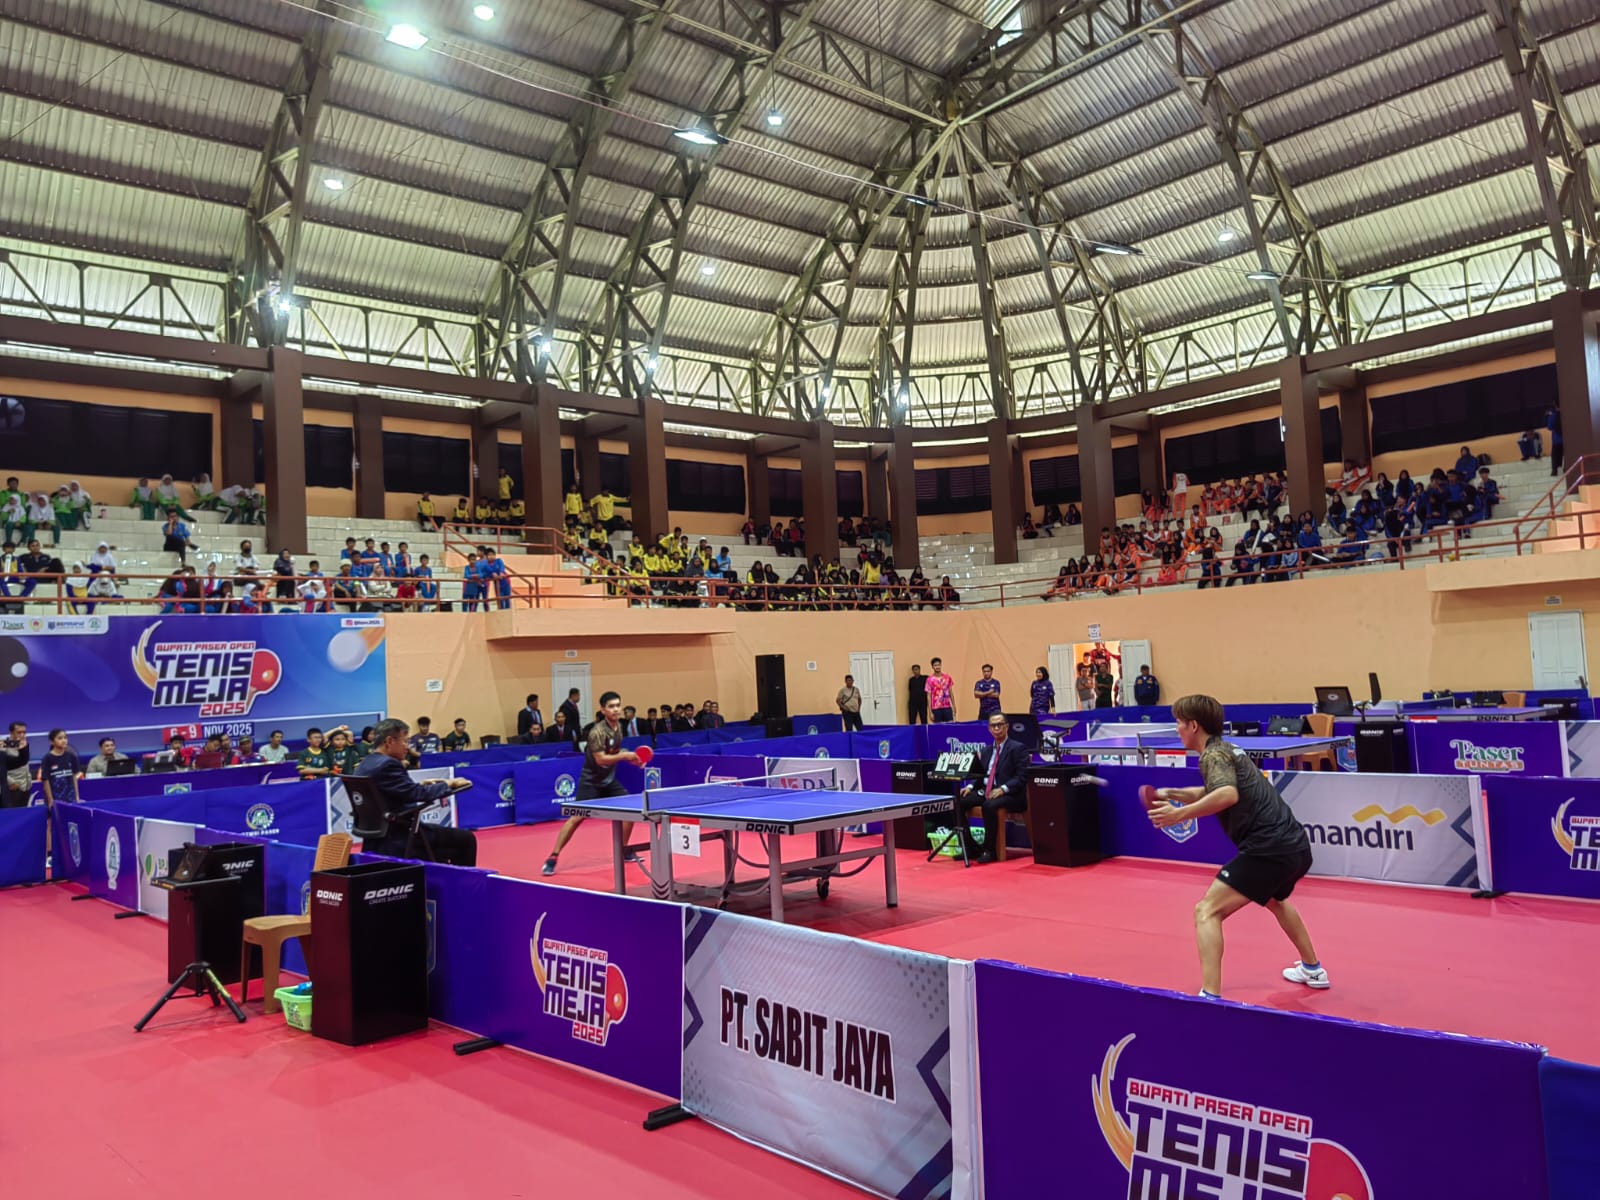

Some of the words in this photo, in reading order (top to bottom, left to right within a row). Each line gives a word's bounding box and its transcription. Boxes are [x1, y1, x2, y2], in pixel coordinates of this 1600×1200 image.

[156, 643, 192, 652] BUPATI
[195, 642, 227, 651] PASER
[230, 642, 256, 650] OPEN
[154, 652, 254, 679] TENIS
[154, 677, 250, 706] MEJA
[201, 702, 246, 716] 2025
[189, 724, 197, 738] 9
[226, 723, 252, 736] 2025
[1450, 739, 1524, 761] Paser
[962, 757, 970, 770] 2
[563, 808, 591, 817] DONIC
[912, 802, 950, 815] DONIC
[745, 823, 785, 834] DONIC
[1303, 820, 1414, 850] mandiri
[682, 835, 690, 850] 3
[316, 890, 343, 901] DONIC
[364, 884, 414, 900] DONIC
[544, 940, 566, 953] BUPATI
[566, 944, 588, 957] PASER
[589, 950, 607, 961] OPEN
[543, 952, 607, 996] TENIS
[544, 984, 605, 1028] MEJA
[573, 1021, 604, 1045] 2025
[721, 987, 749, 1052] PT.
[754, 997, 828, 1076] SABIT
[832, 1020, 895, 1101] JAYA
[1129, 1081, 1189, 1107] BUPATI
[1193, 1095, 1253, 1122] PASER
[1258, 1110, 1310, 1135] OPEN
[1127, 1100, 1309, 1194] TENIS
